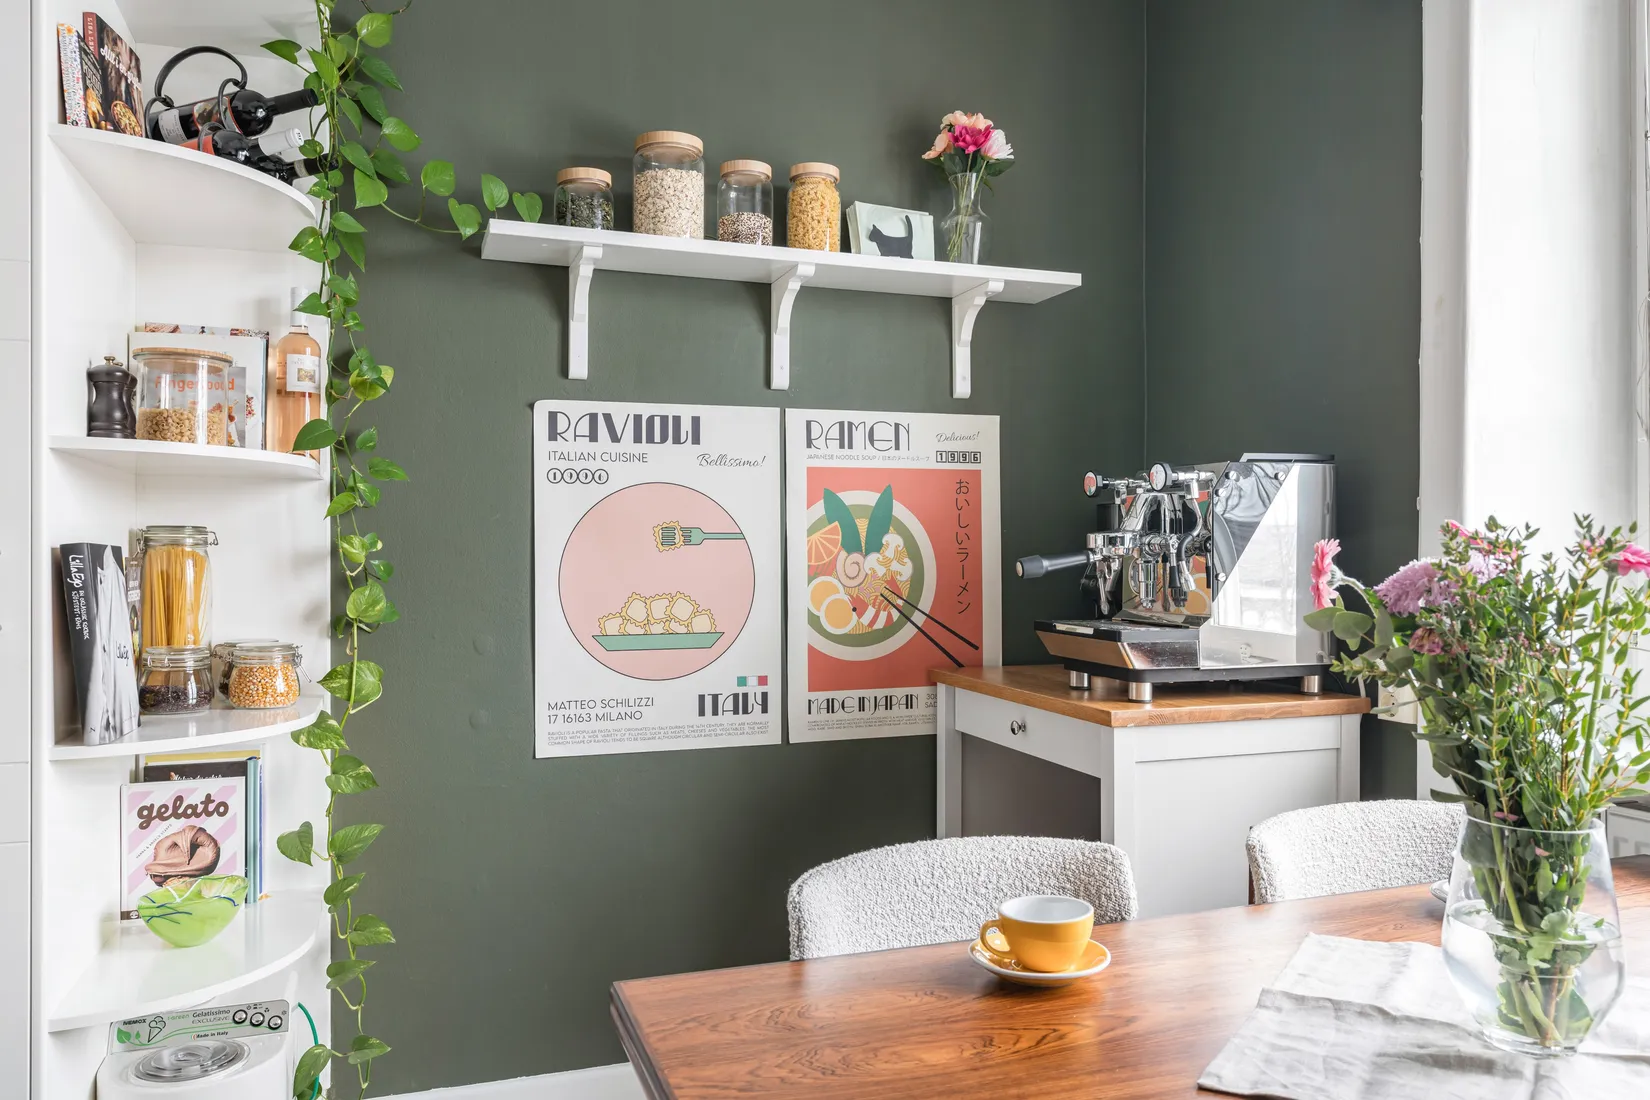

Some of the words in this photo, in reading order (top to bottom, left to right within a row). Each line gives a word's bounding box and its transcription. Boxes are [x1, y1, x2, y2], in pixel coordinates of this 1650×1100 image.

[548, 411, 700, 445] RAVIOLI
[806, 420, 909, 451] RAMEN
[936, 431, 980, 442] Delicious!
[549, 451, 596, 461] ITALIAN
[601, 452, 648, 463] CUISINE
[697, 453, 766, 467] Bellissimo!
[936, 451, 981, 464] 1996
[547, 468, 609, 484] 1996
[956, 478, 971, 615] おいしいラーメン
[548, 700, 596, 710] MATTEO
[601, 697, 653, 709] SCHILIZZI
[698, 692, 768, 717] ITALY
[808, 697, 854, 715] MADE
[858, 697, 870, 712] IN
[871, 694, 918, 715] JAPAN
[548, 714, 558, 724] 17
[562, 713, 591, 723] 16163
[596, 711, 642, 722] MILANO
[137, 793, 229, 829] gelato
[193, 1008, 230, 1018] Gelatissimo
